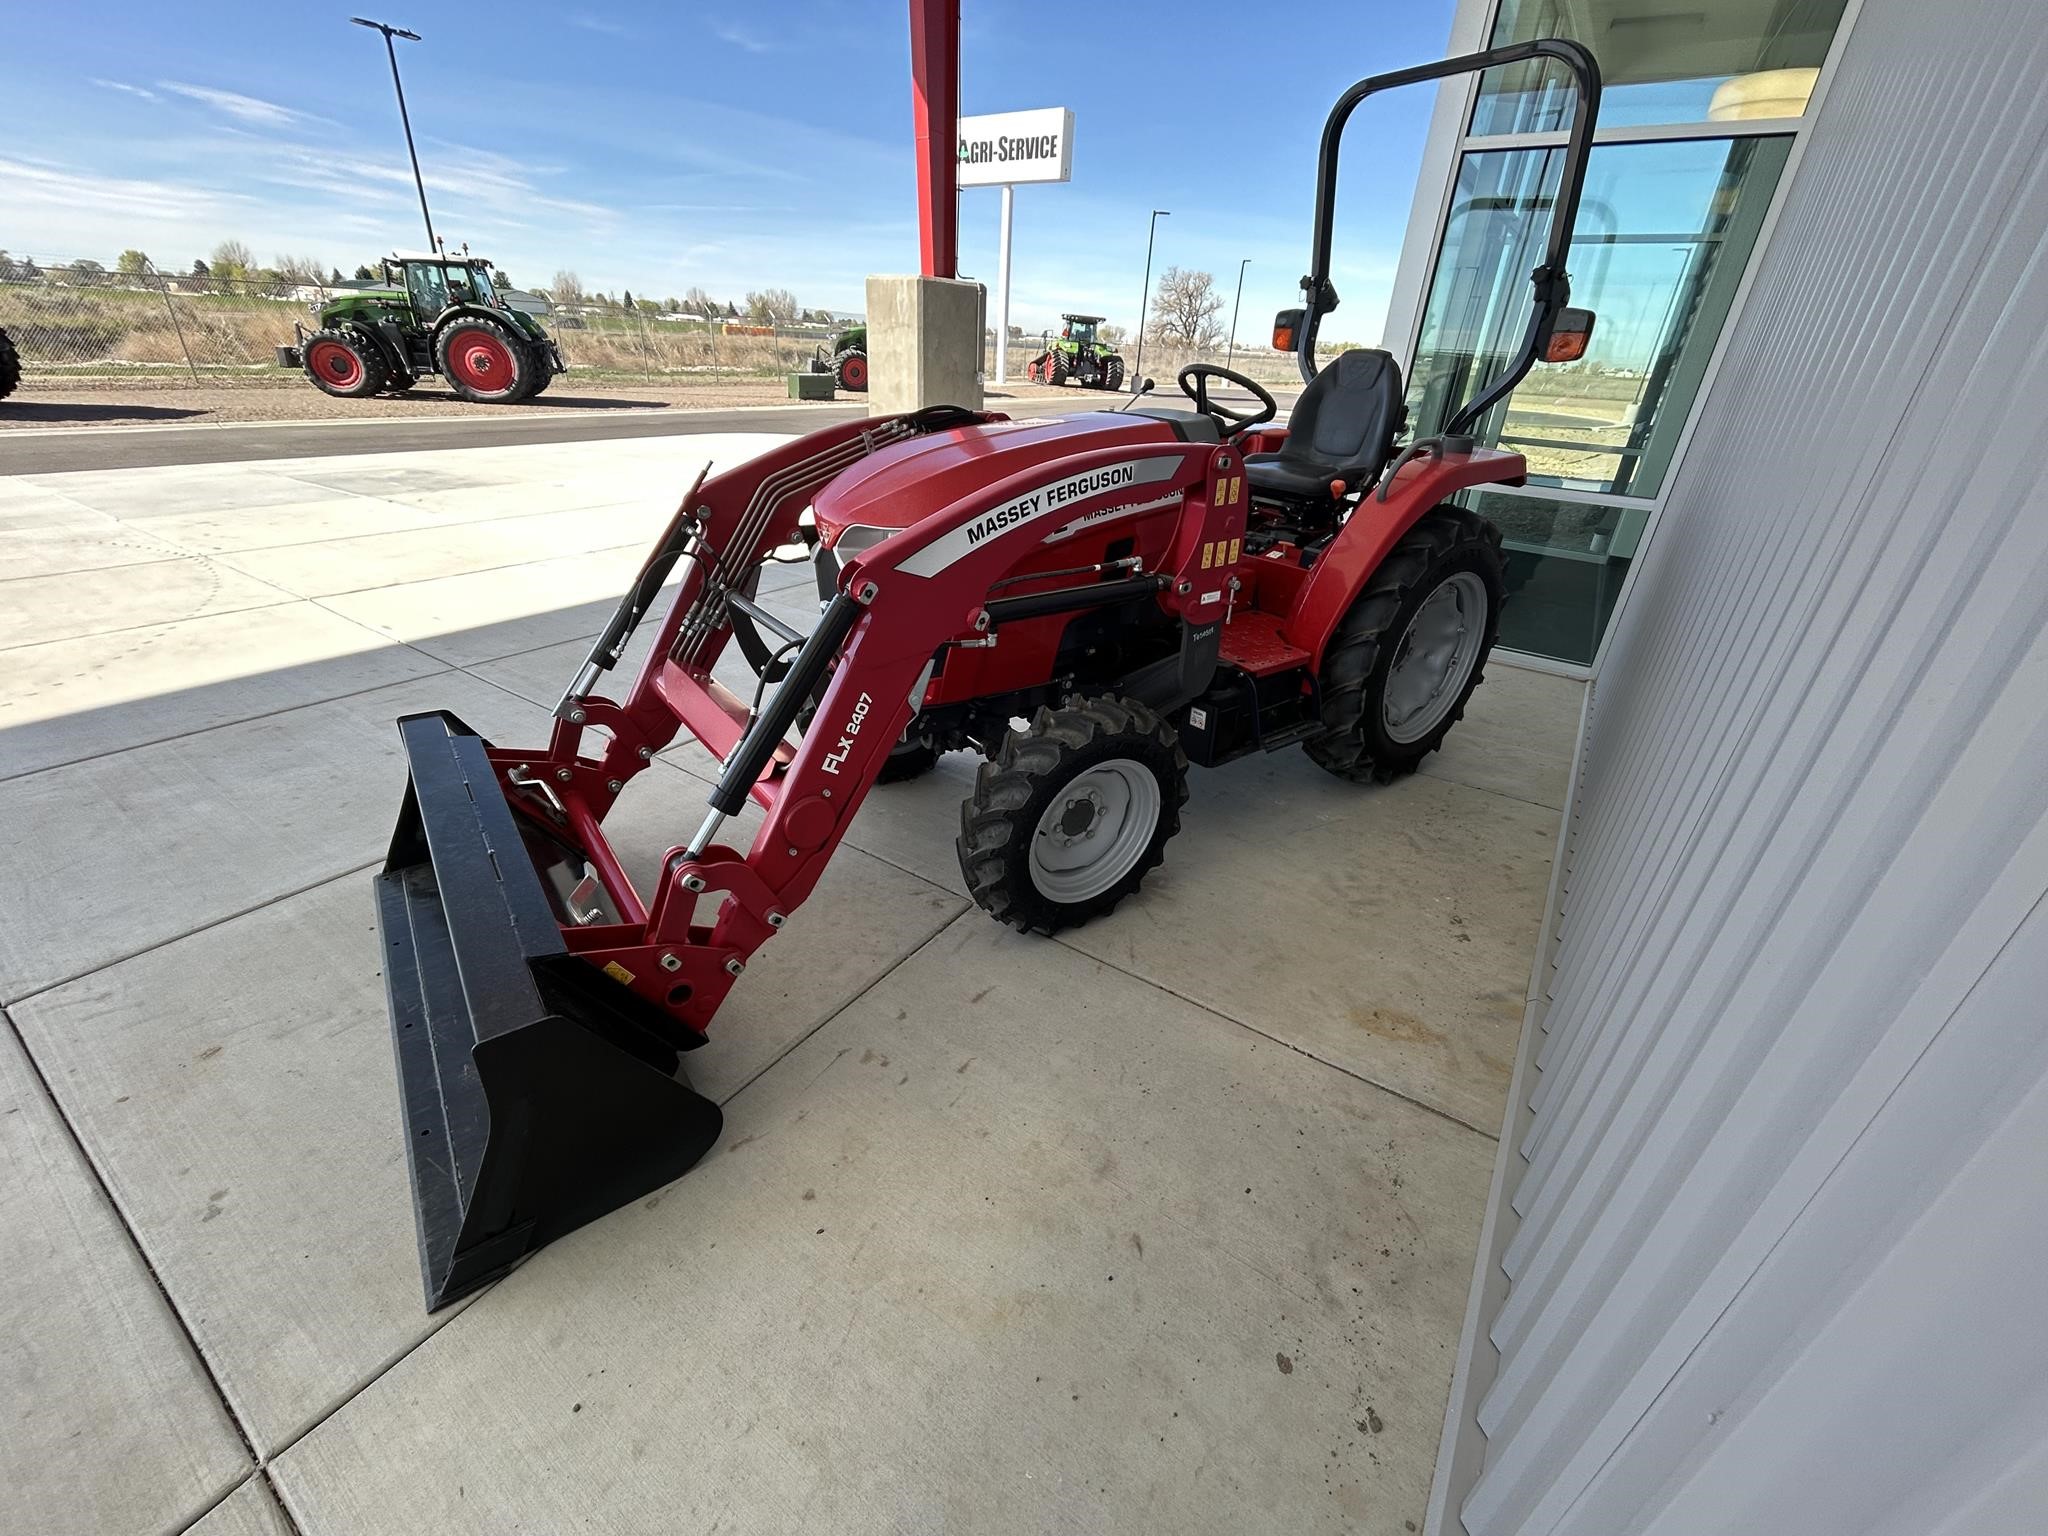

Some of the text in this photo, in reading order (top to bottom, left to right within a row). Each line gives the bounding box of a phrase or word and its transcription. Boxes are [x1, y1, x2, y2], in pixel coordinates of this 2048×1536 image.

[959, 135, 1058, 164] AGRI-SERVICE
[966, 495, 1041, 544] MASSEY
[1046, 466, 1134, 507] FERGUSON
[821, 692, 873, 775] FLX 2407
